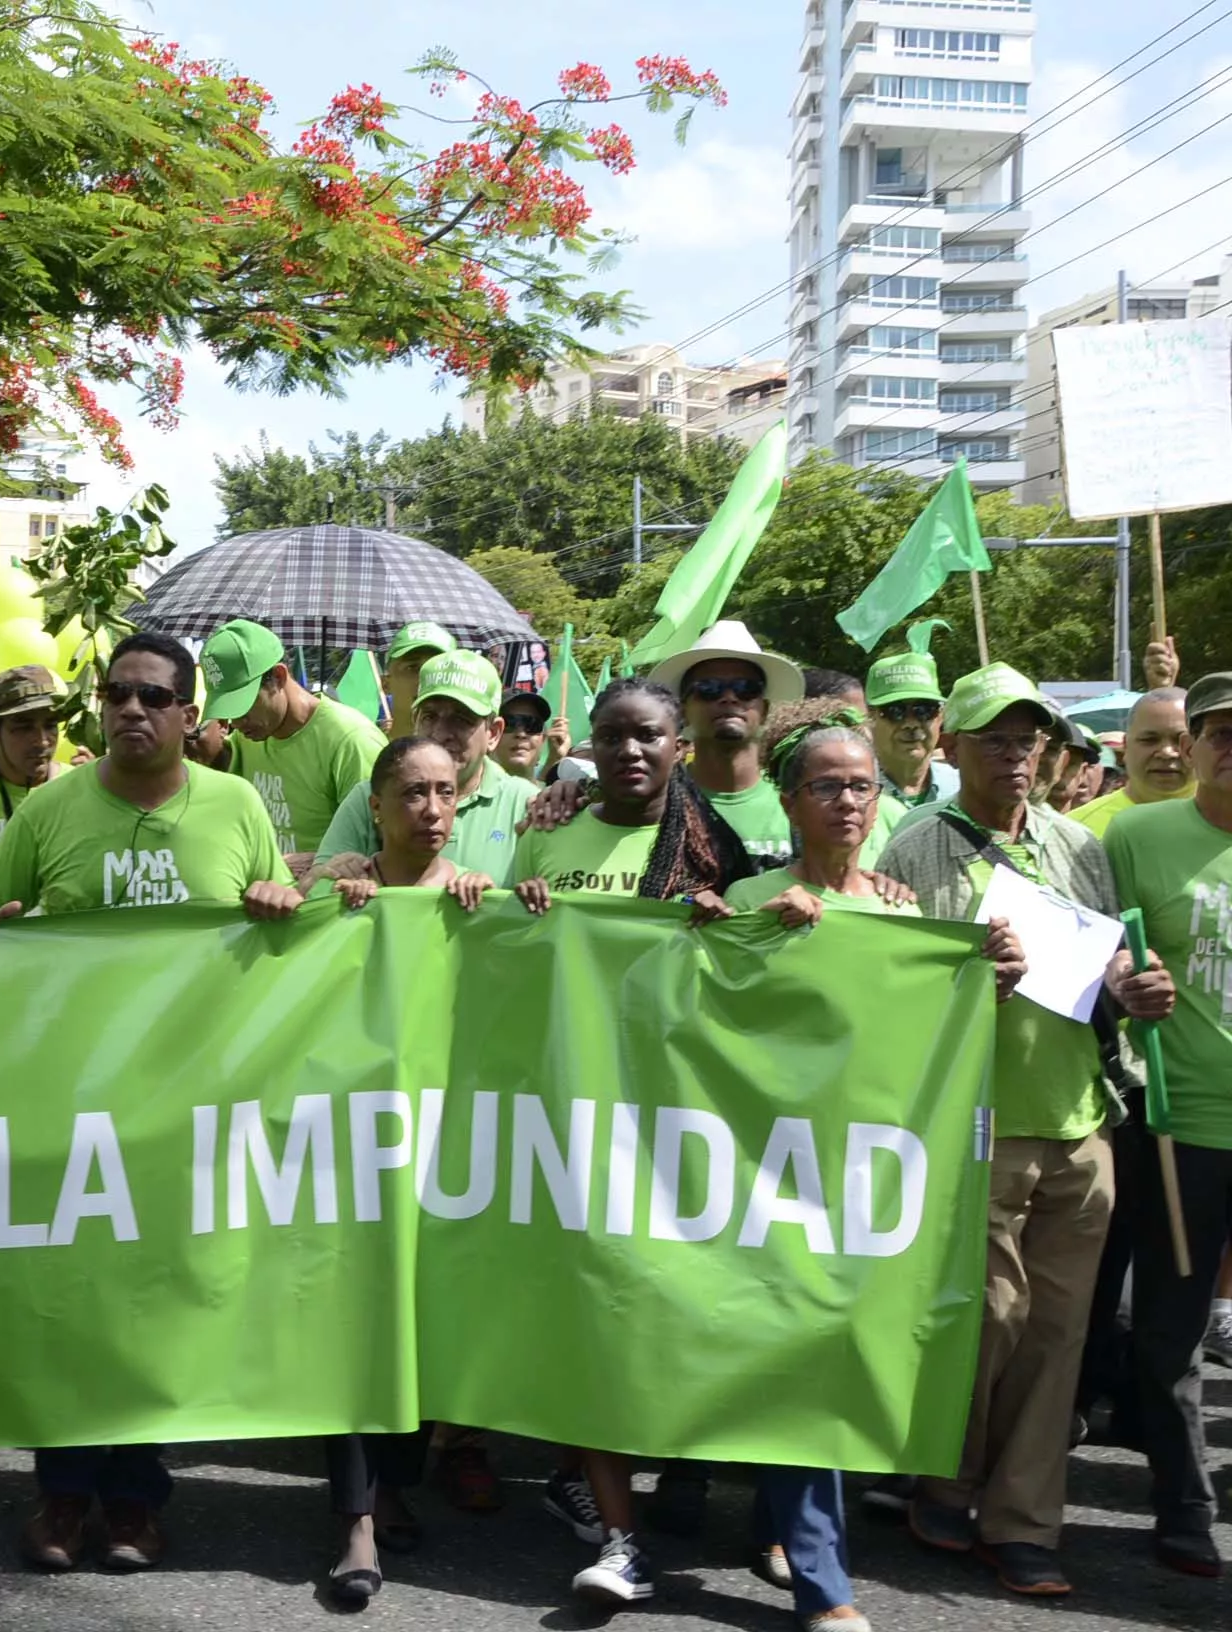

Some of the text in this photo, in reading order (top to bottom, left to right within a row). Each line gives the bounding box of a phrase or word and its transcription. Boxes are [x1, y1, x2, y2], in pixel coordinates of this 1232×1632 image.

[425, 671, 488, 694] IMPUNIDAD
[104, 848, 178, 904] MAR
[554, 869, 615, 892] #Soy
[135, 879, 189, 906] CHA
[1194, 937, 1227, 956] DEL
[191, 1087, 928, 1258] IMPUNIDAD
